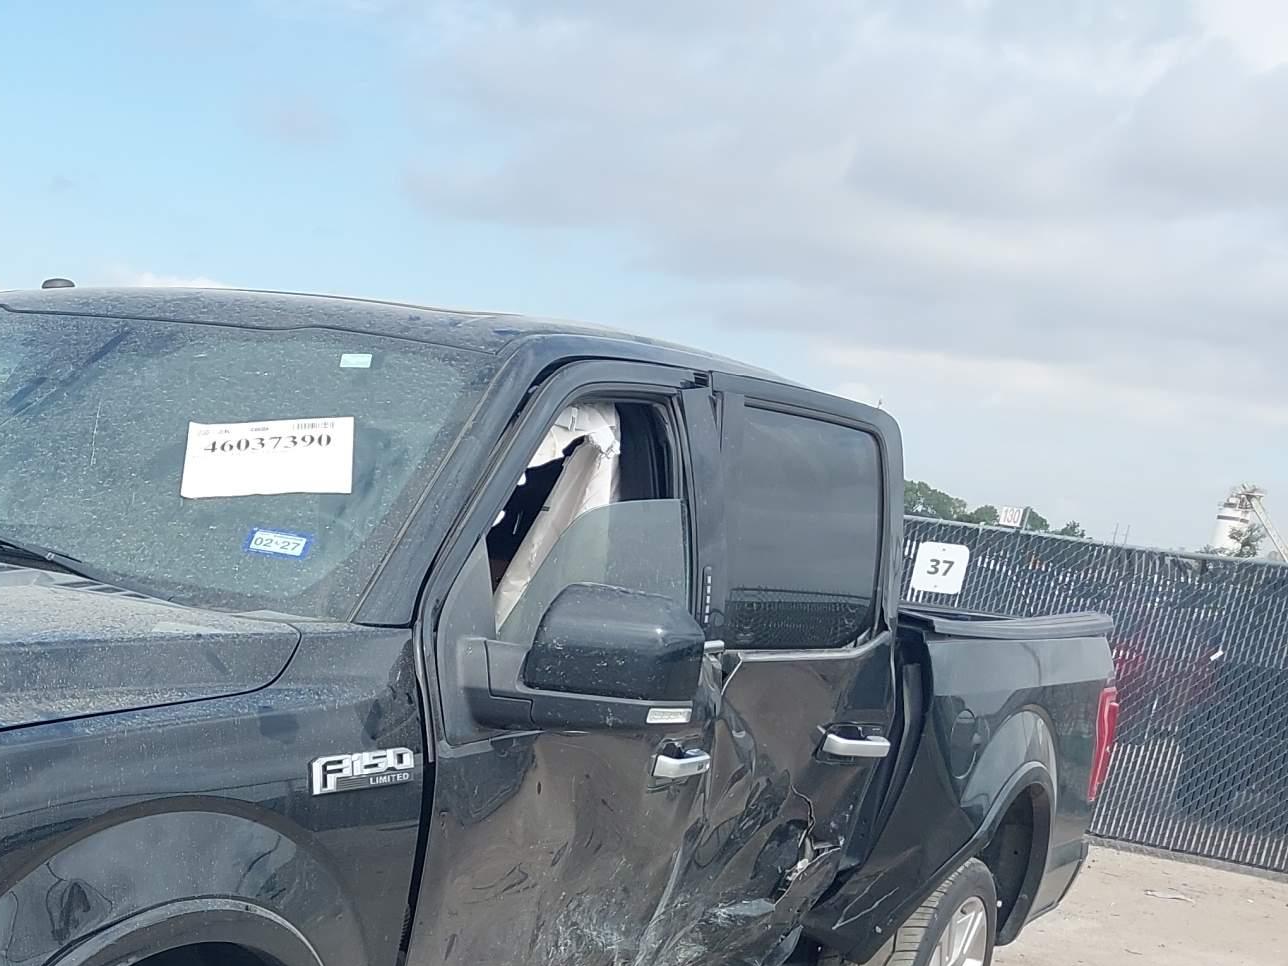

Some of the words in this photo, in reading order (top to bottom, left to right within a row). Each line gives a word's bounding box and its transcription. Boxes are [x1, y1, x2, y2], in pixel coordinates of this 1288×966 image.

[203, 433, 332, 453] 46037390
[926, 558, 955, 577] 37
[369, 772, 410, 785] LIMITED
